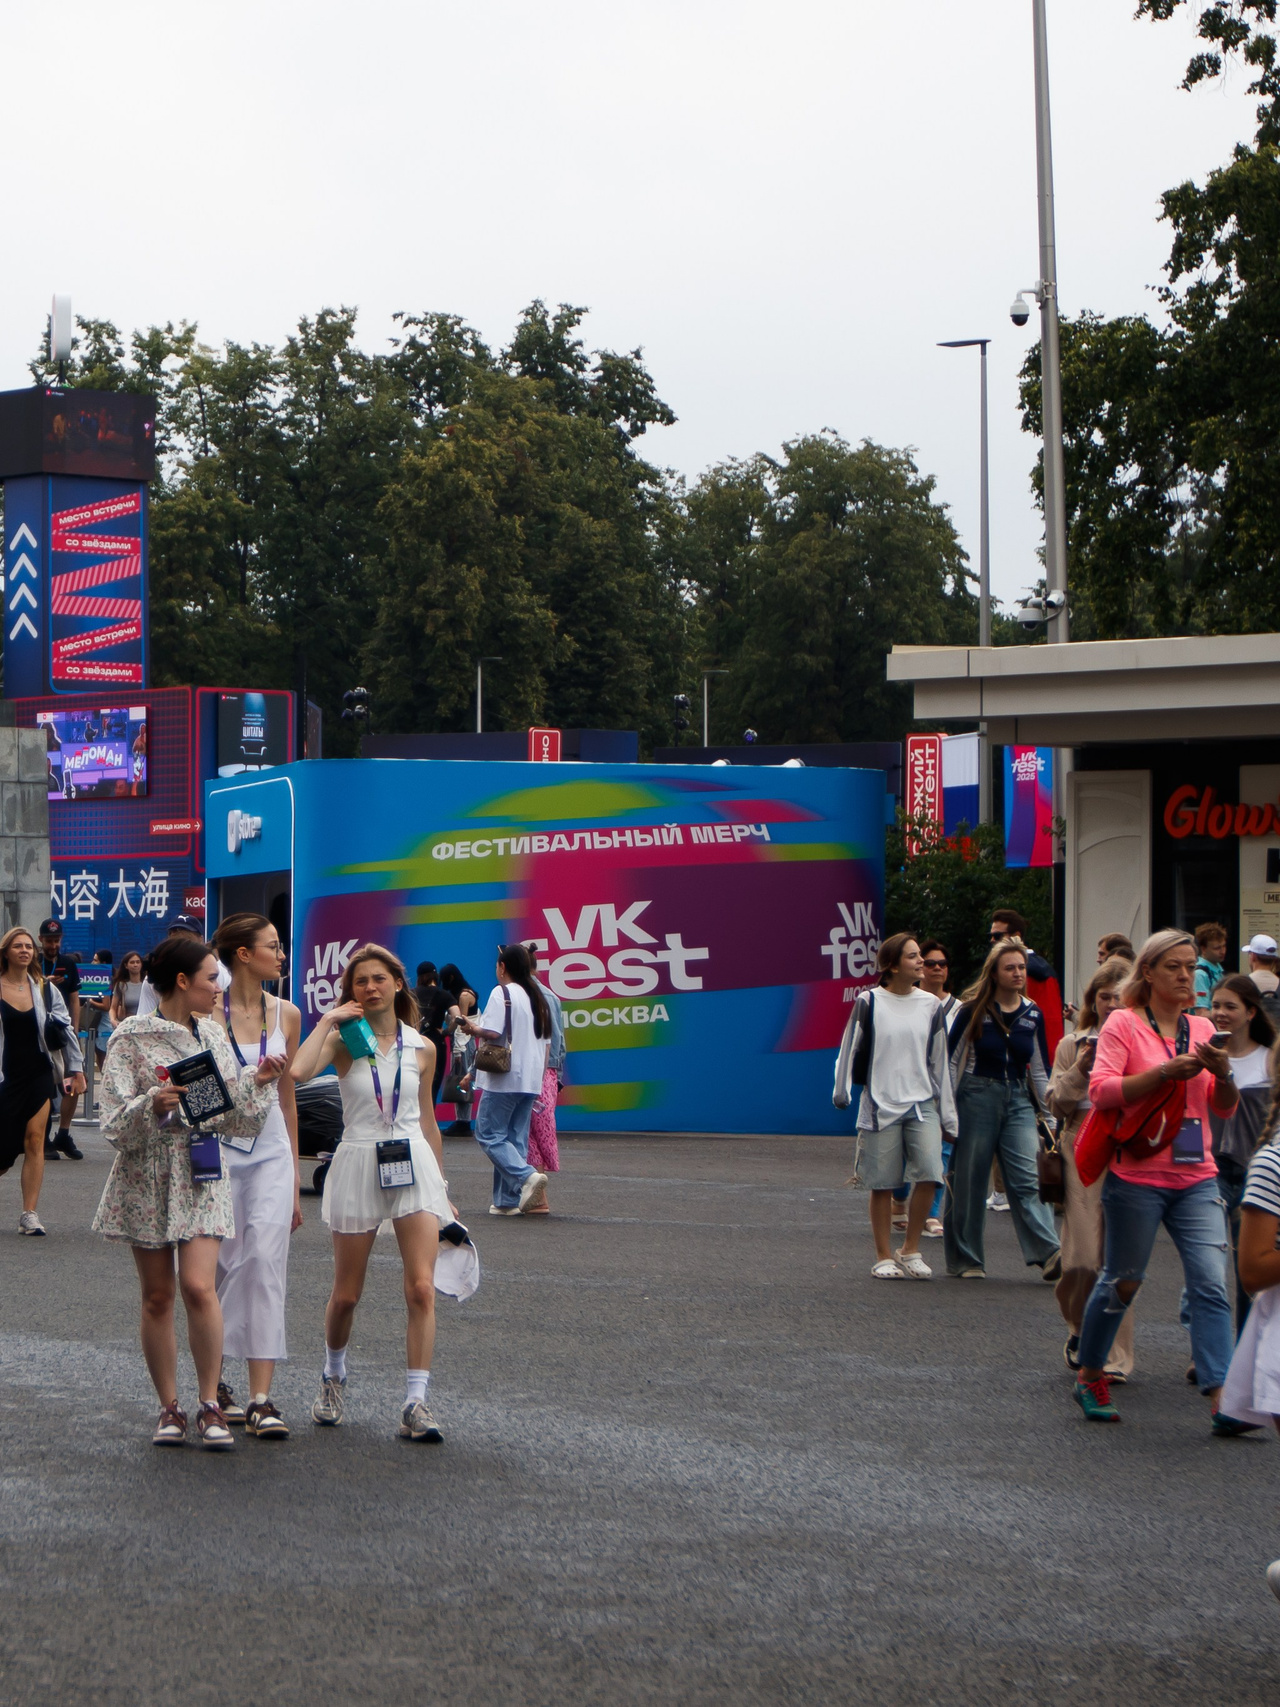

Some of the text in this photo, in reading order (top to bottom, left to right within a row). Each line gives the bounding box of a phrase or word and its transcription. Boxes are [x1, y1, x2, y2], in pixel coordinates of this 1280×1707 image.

[59, 500, 136, 525] место встречи
[65, 538, 131, 550] со звёздами
[59, 626, 137, 653] место встречи
[66, 665, 133, 677] со звёздами
[64, 745, 123, 769] МЕЛОМАН
[1011, 757, 1046, 774] fest
[1021, 751, 1037, 762] VK
[1016, 773, 1036, 781] 2025
[431, 823, 771, 860] ФЕСТИВАЛЬНЫЙ МЕРЧ
[542, 900, 659, 950] VK
[836, 902, 876, 937] VK
[314, 938, 359, 977] VK
[79, 975, 110, 985] ЫХОД
